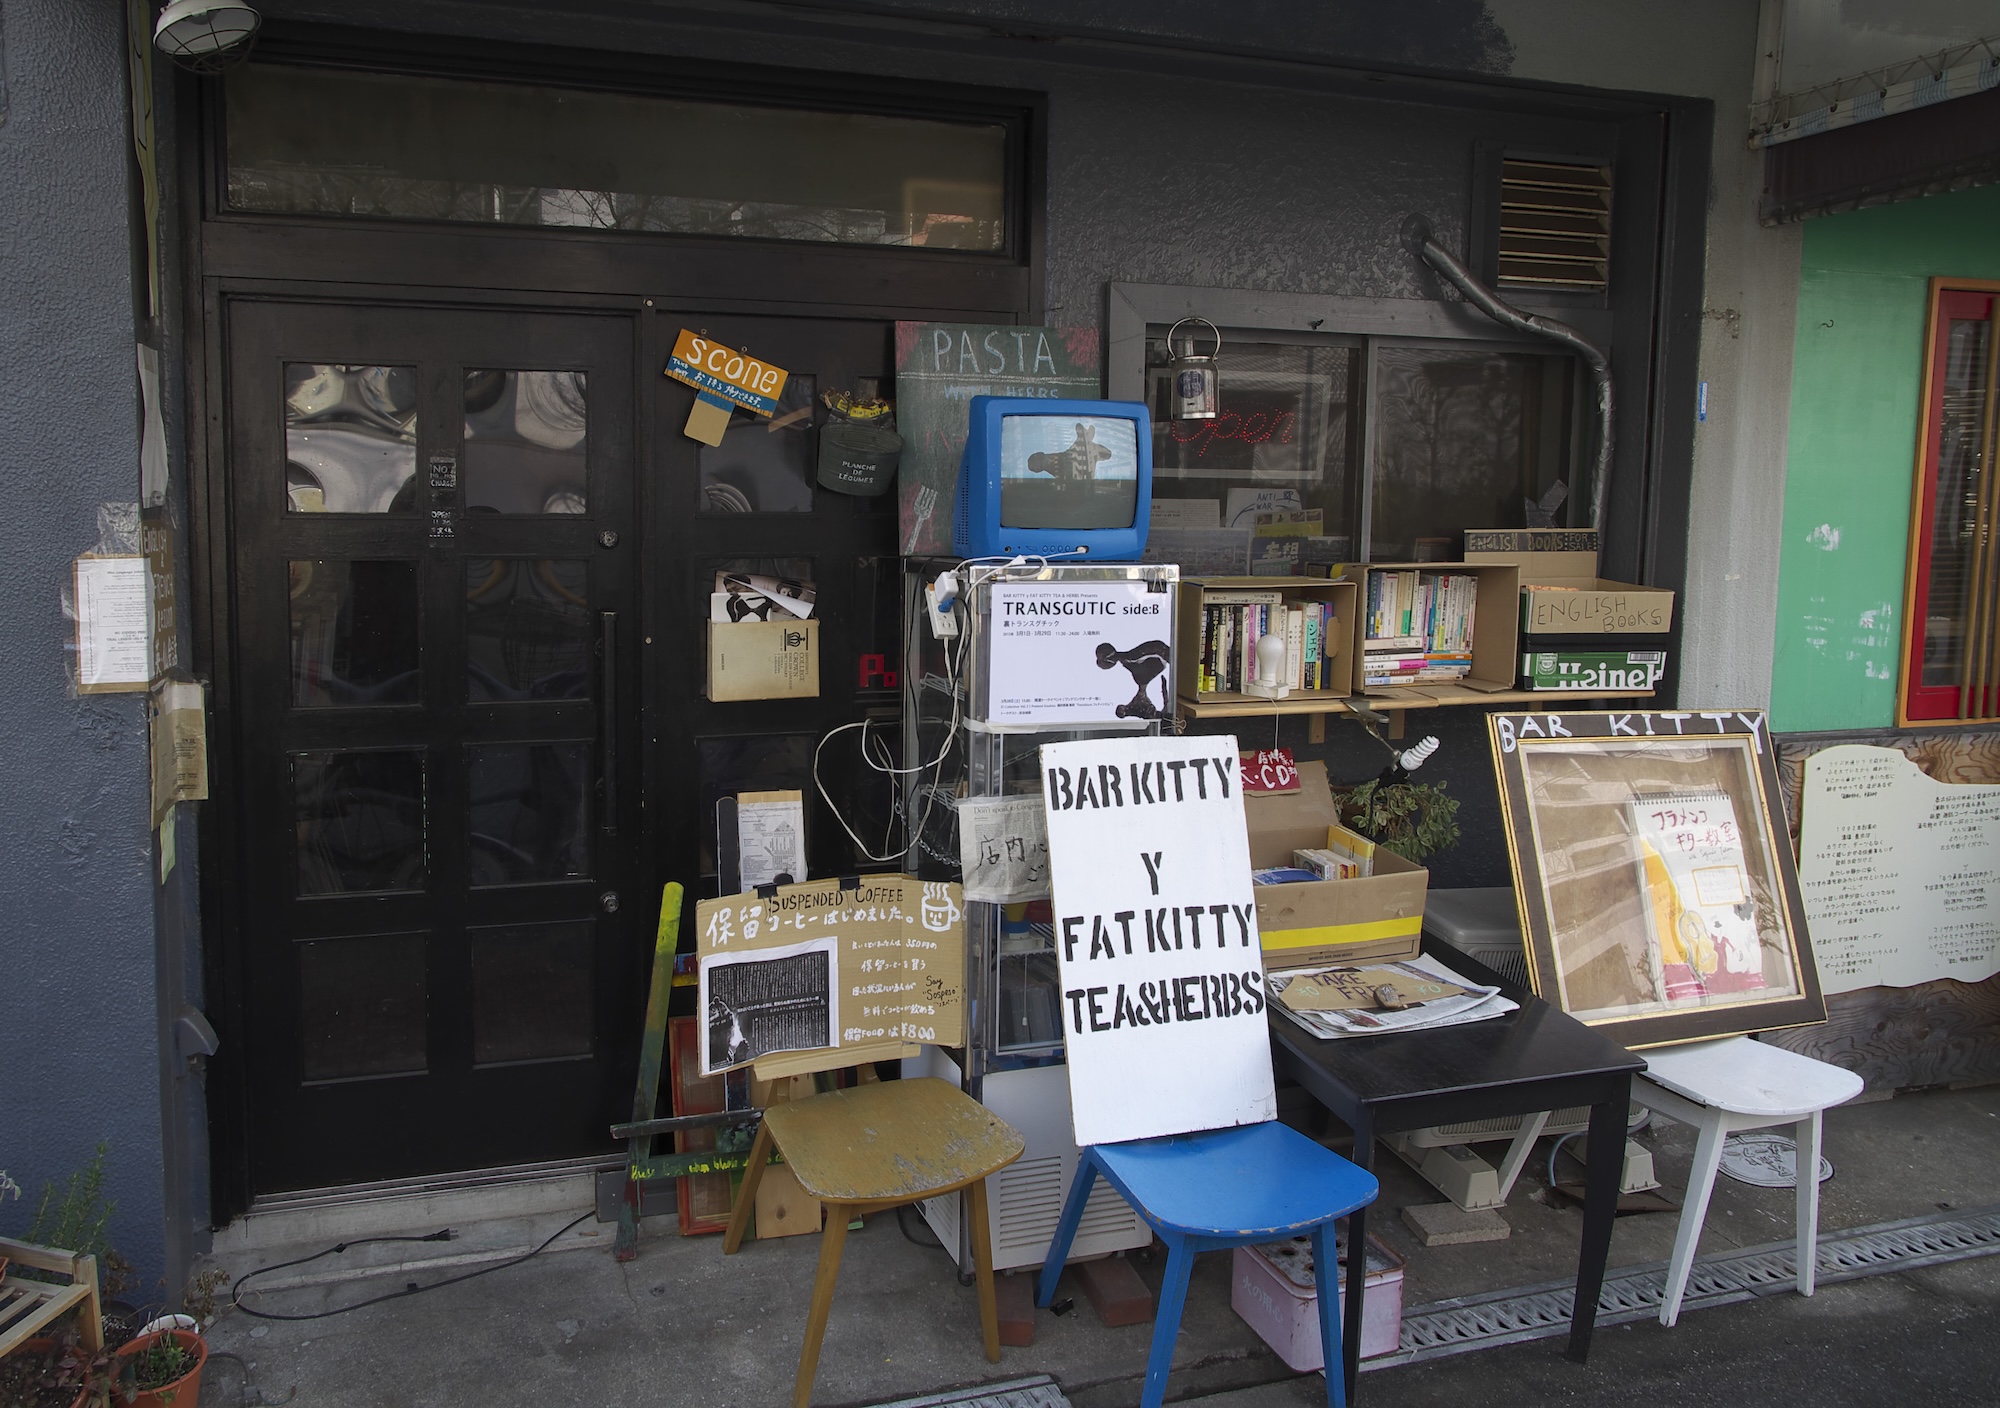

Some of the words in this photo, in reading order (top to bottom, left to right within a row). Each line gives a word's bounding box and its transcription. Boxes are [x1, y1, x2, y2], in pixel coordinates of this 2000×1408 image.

[932, 328, 1057, 375] PASTA
[943, 384, 992, 400] WITH
[1006, 386, 1059, 399] HERBS
[432, 464, 448, 473] NO
[841, 460, 877, 472] PLANCHE
[1255, 502, 1273, 511] WAR
[1256, 492, 1276, 501] ANTI
[1468, 532, 1519, 551] ENGLISH
[1526, 532, 1564, 551] BOOKS
[1568, 541, 1594, 551] SALE
[1569, 532, 1588, 542] FOR
[1002, 601, 1117, 616] TRANSGUTIC
[1122, 603, 1160, 615] side:B
[1537, 596, 1627, 625] ENGLISH
[1003, 619, 1060, 628] 裏トランスグチック
[1602, 608, 1662, 633] BOOKS
[1496, 714, 1573, 753] BAR
[1608, 712, 1765, 755] KITTY
[1047, 764, 1124, 811] BAR
[1130, 756, 1234, 806] KITTY
[1650, 808, 1709, 831] フラメンコ
[1675, 820, 1738, 853] ギター教室
[1139, 850, 1163, 897] Y
[768, 889, 844, 914] SUSPENDED
[854, 883, 904, 904] COFFEE
[705, 904, 914, 947] 保留コーヒーはじめました。
[1061, 908, 1136, 962] FAT
[1144, 903, 1254, 954] KITTY
[925, 974, 944, 990] Say
[1303, 972, 1367, 987] TAKE
[1065, 970, 1265, 1035] TEA&HERBS
[1241, 1274, 1284, 1324] 火の用心
